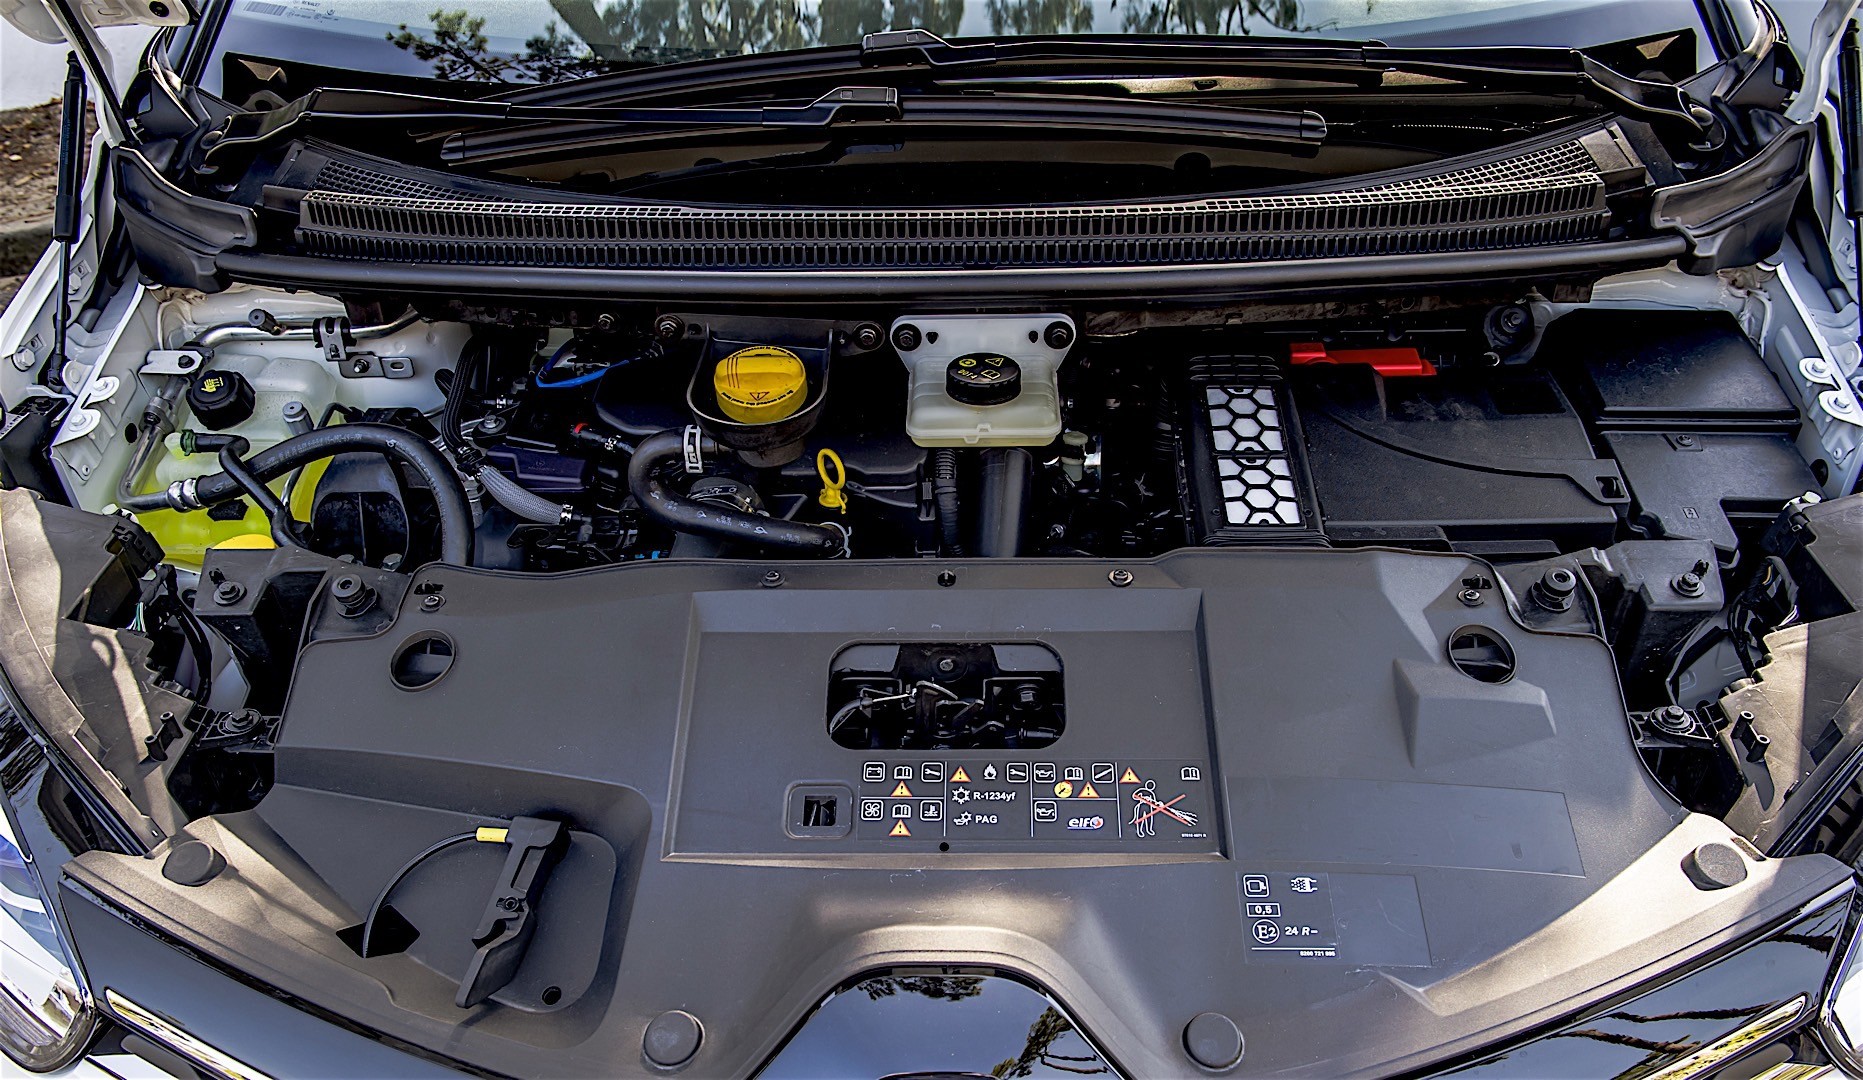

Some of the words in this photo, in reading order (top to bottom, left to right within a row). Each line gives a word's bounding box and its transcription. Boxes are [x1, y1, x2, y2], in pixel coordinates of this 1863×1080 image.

[973, 791, 1016, 802] R-1234yf
[975, 814, 998, 824] PAG
[1255, 905, 1272, 915] 0,5
[1257, 924, 1277, 939] E2
[1284, 926, 1299, 936] 24
